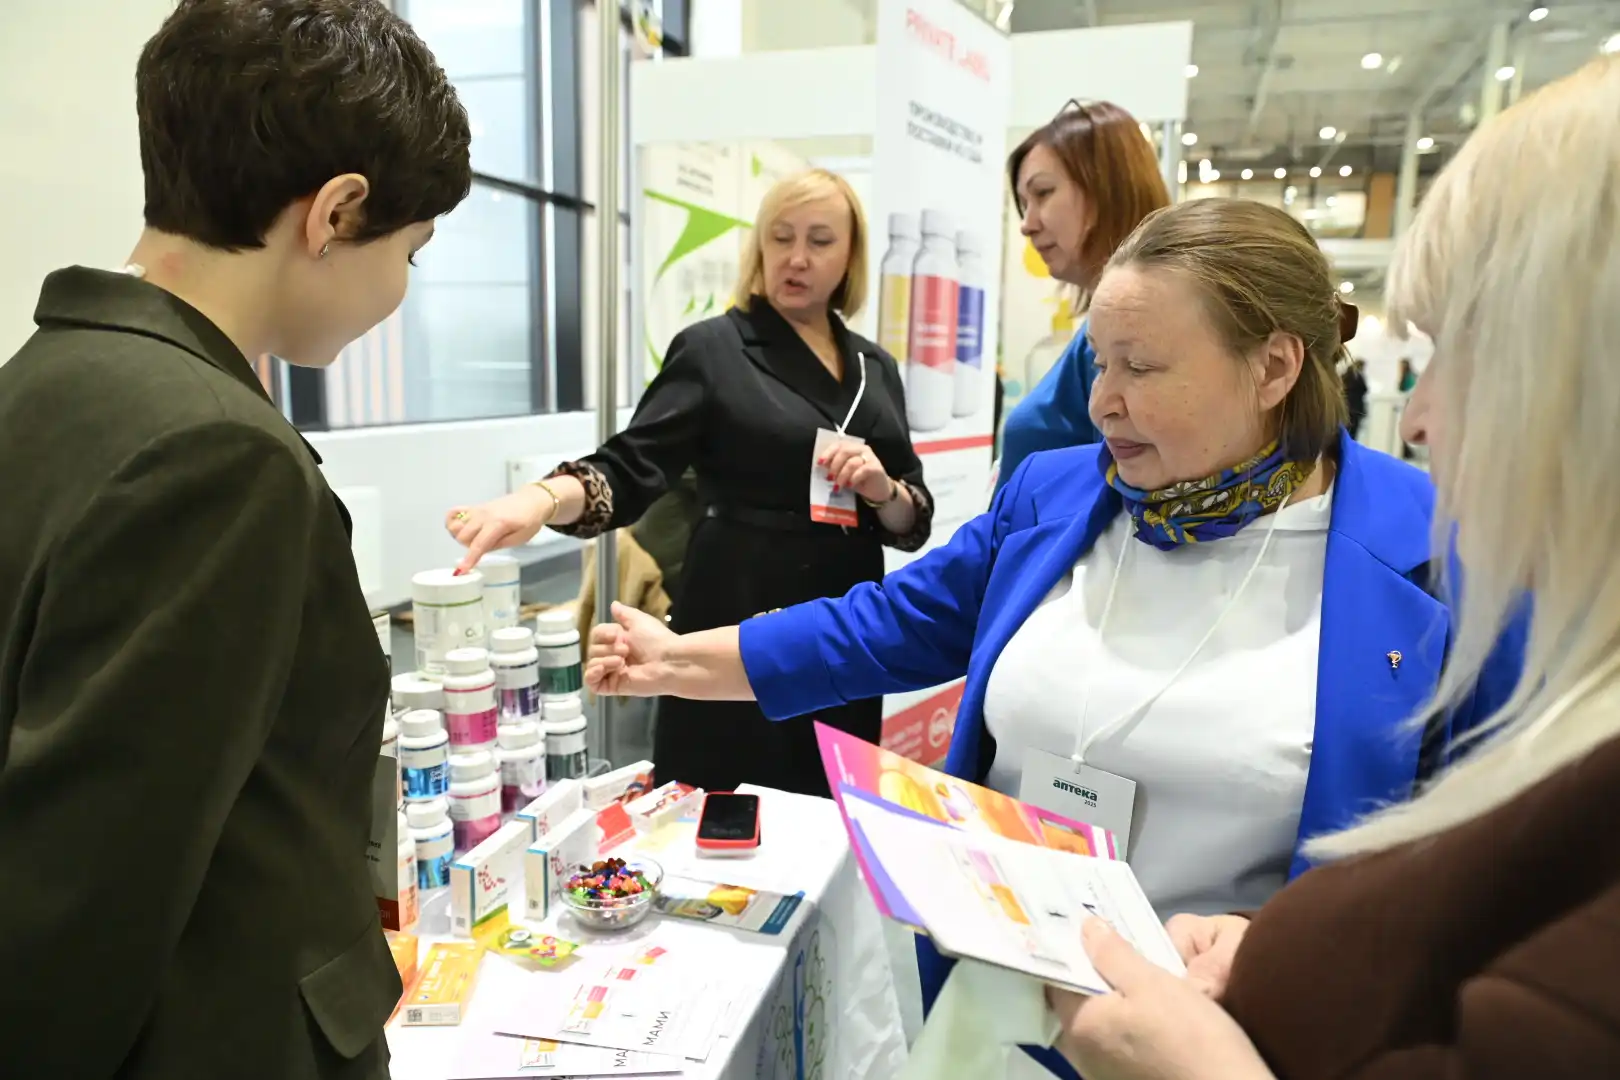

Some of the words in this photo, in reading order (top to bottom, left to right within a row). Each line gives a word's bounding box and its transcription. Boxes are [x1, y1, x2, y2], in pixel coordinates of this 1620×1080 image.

[1053, 779, 1098, 801] аптека
[1084, 799, 1097, 808] 2025
[642, 1011, 671, 1046] МАМИ
